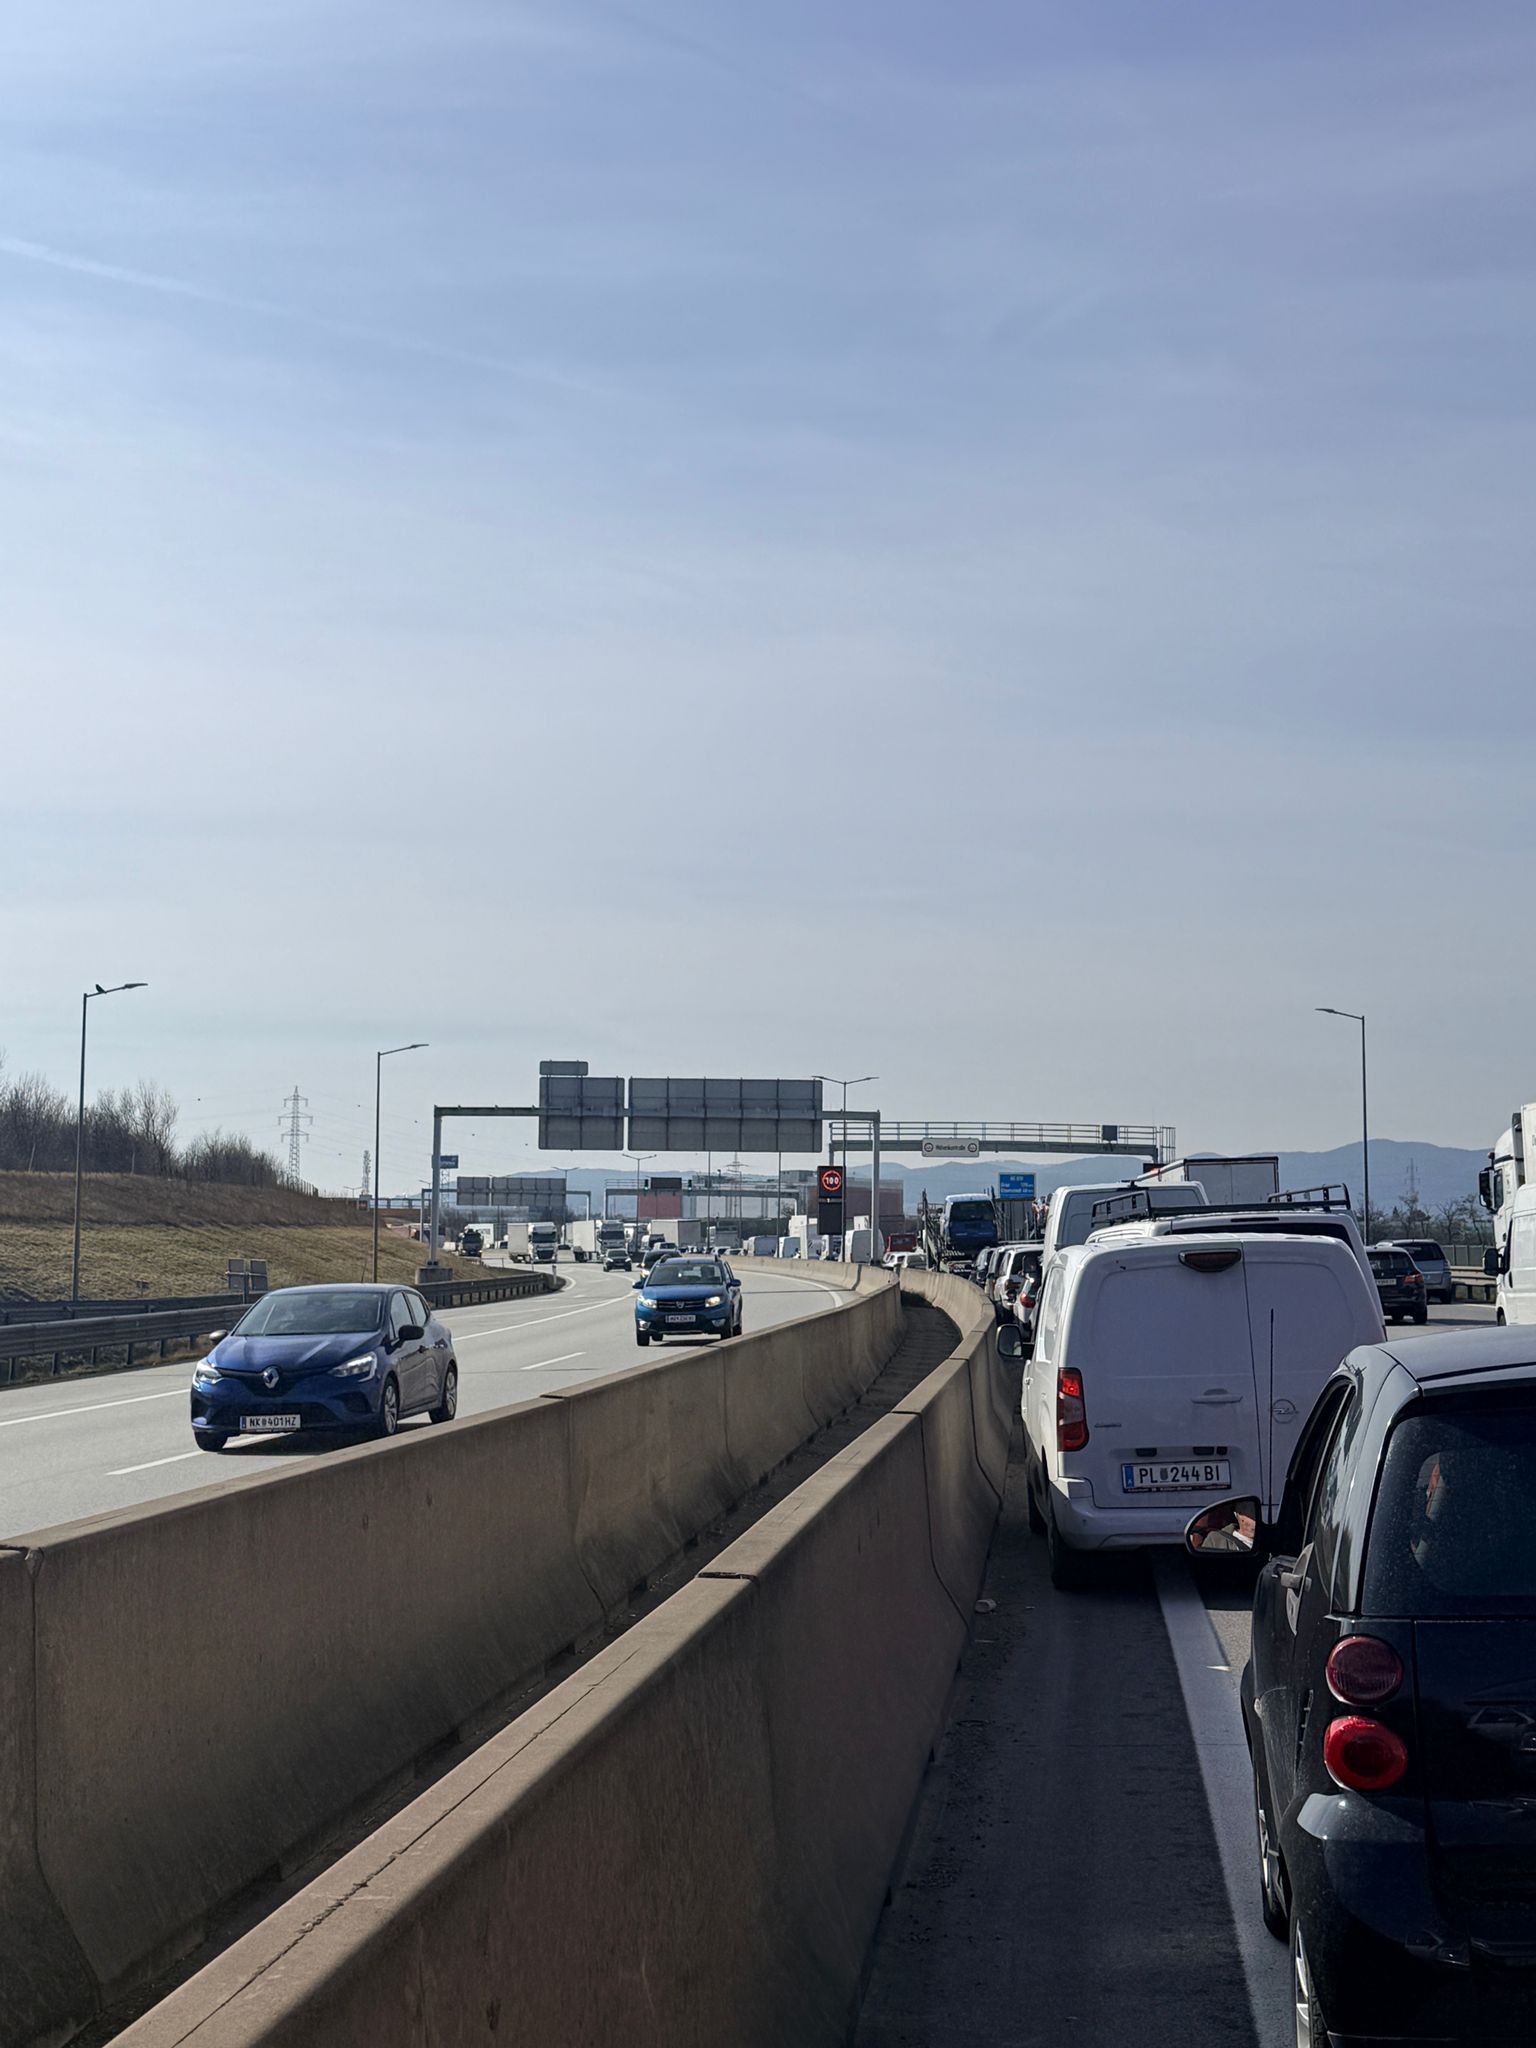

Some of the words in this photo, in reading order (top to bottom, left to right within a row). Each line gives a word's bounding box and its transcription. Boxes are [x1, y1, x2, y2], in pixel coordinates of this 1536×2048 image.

[825, 1176, 839, 1185] 100
[249, 1417, 261, 1427] NK
[1139, 1467, 1158, 1484] PL
[1170, 1465, 1201, 1483] 244
[1204, 1464, 1220, 1482] BI
